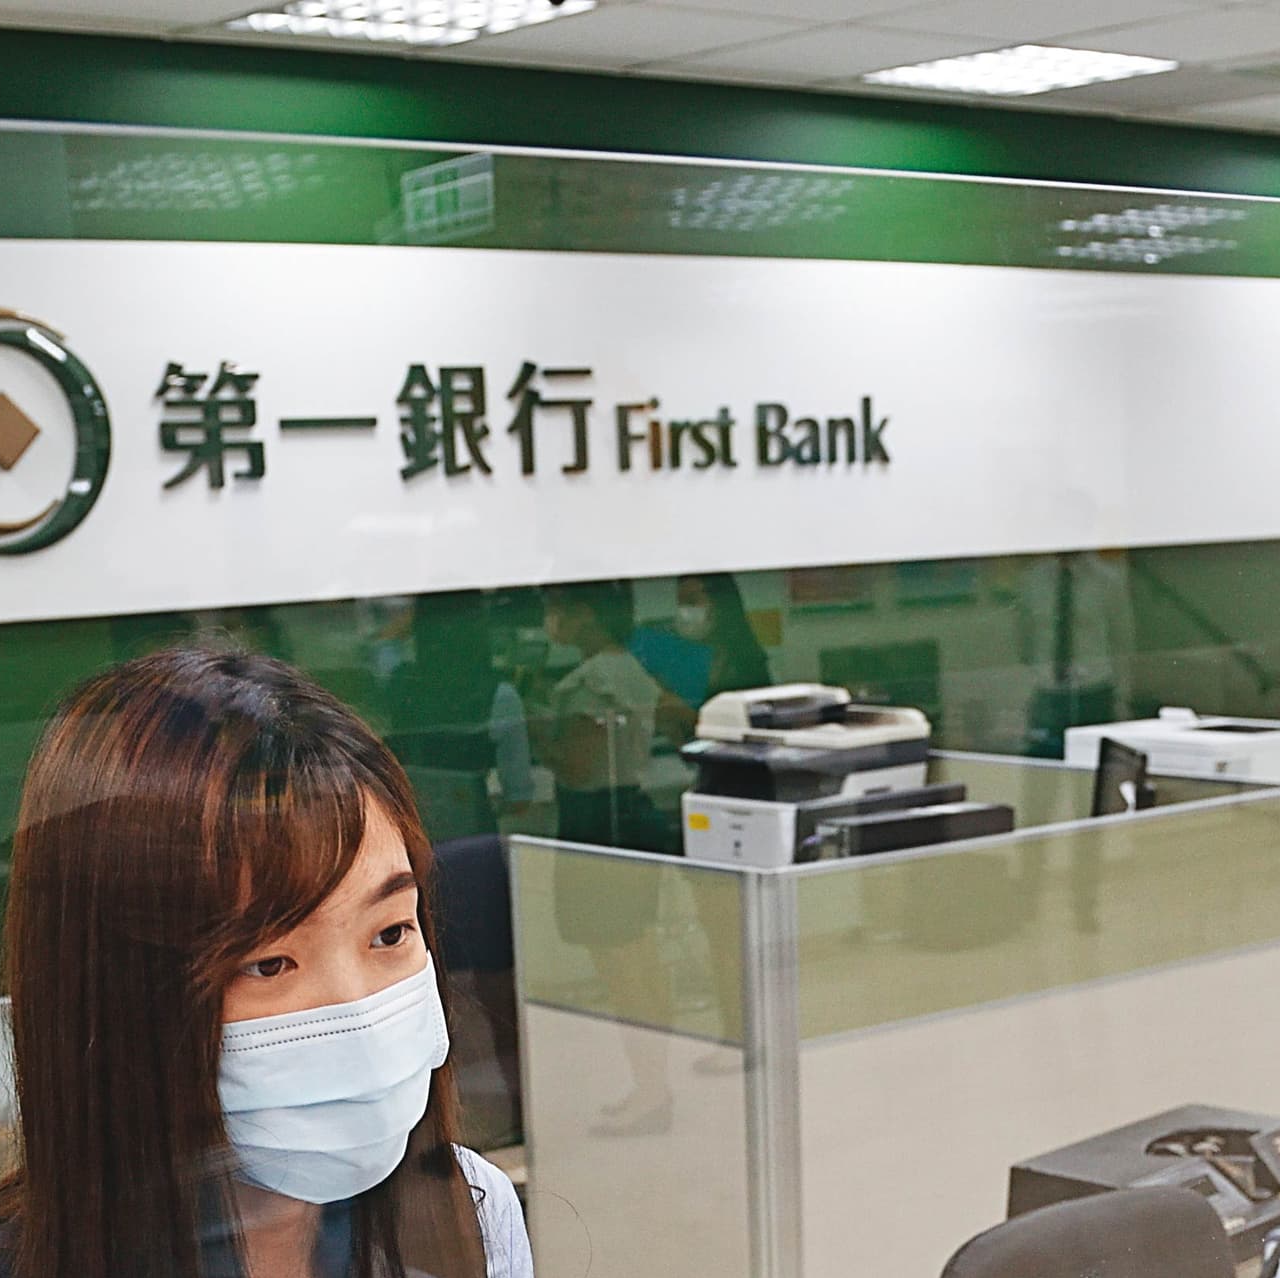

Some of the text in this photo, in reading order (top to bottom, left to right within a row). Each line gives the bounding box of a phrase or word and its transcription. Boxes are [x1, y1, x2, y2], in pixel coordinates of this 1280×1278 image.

[156, 361, 890, 490] 第一銀行 First Bank
